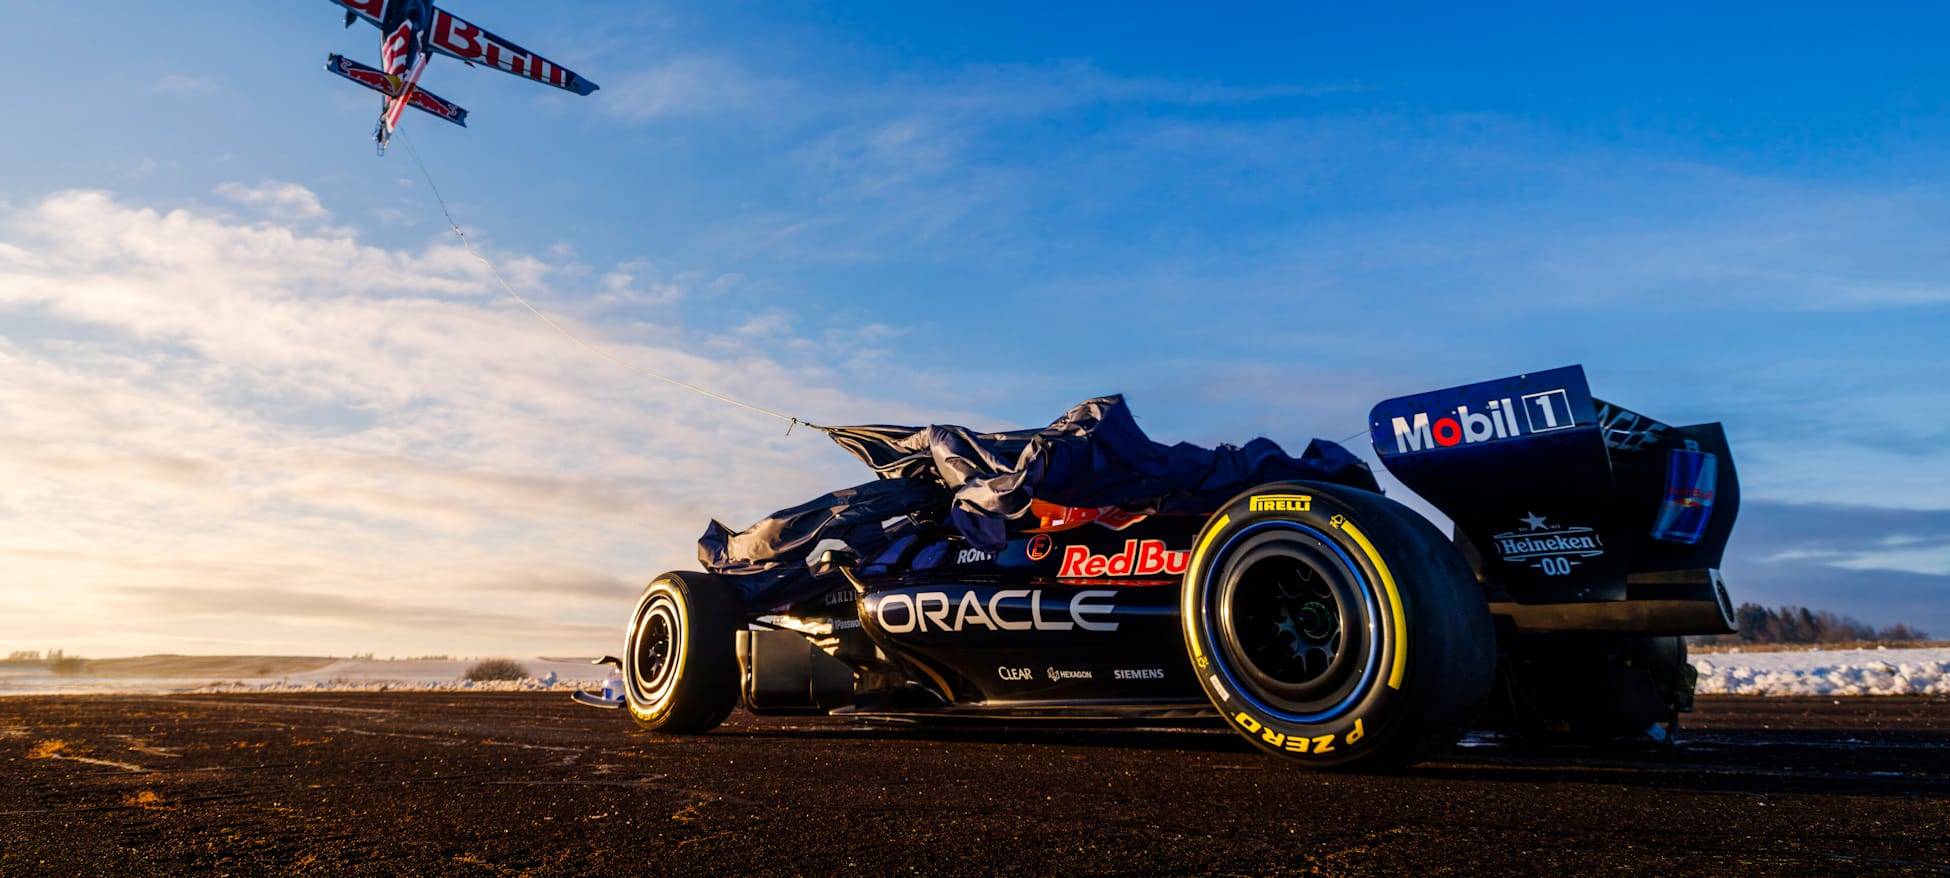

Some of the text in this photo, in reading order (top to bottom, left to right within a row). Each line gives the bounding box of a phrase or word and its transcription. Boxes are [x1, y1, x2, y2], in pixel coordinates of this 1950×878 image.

[430, 7, 566, 87] Bull
[1391, 395, 1560, 453] Mobil 1
[1249, 494, 1312, 512] PIRELLI
[1500, 533, 1595, 555] Heineken
[1057, 539, 1191, 578] Red Bu
[825, 589, 858, 607] CARLYL
[877, 590, 1120, 633] ORACLE
[998, 666, 1033, 681] CLEAR
[1060, 670, 1093, 679] HEXAGON
[1113, 668, 1165, 680] SIEMENS
[1234, 711, 1365, 754] P ZERO
